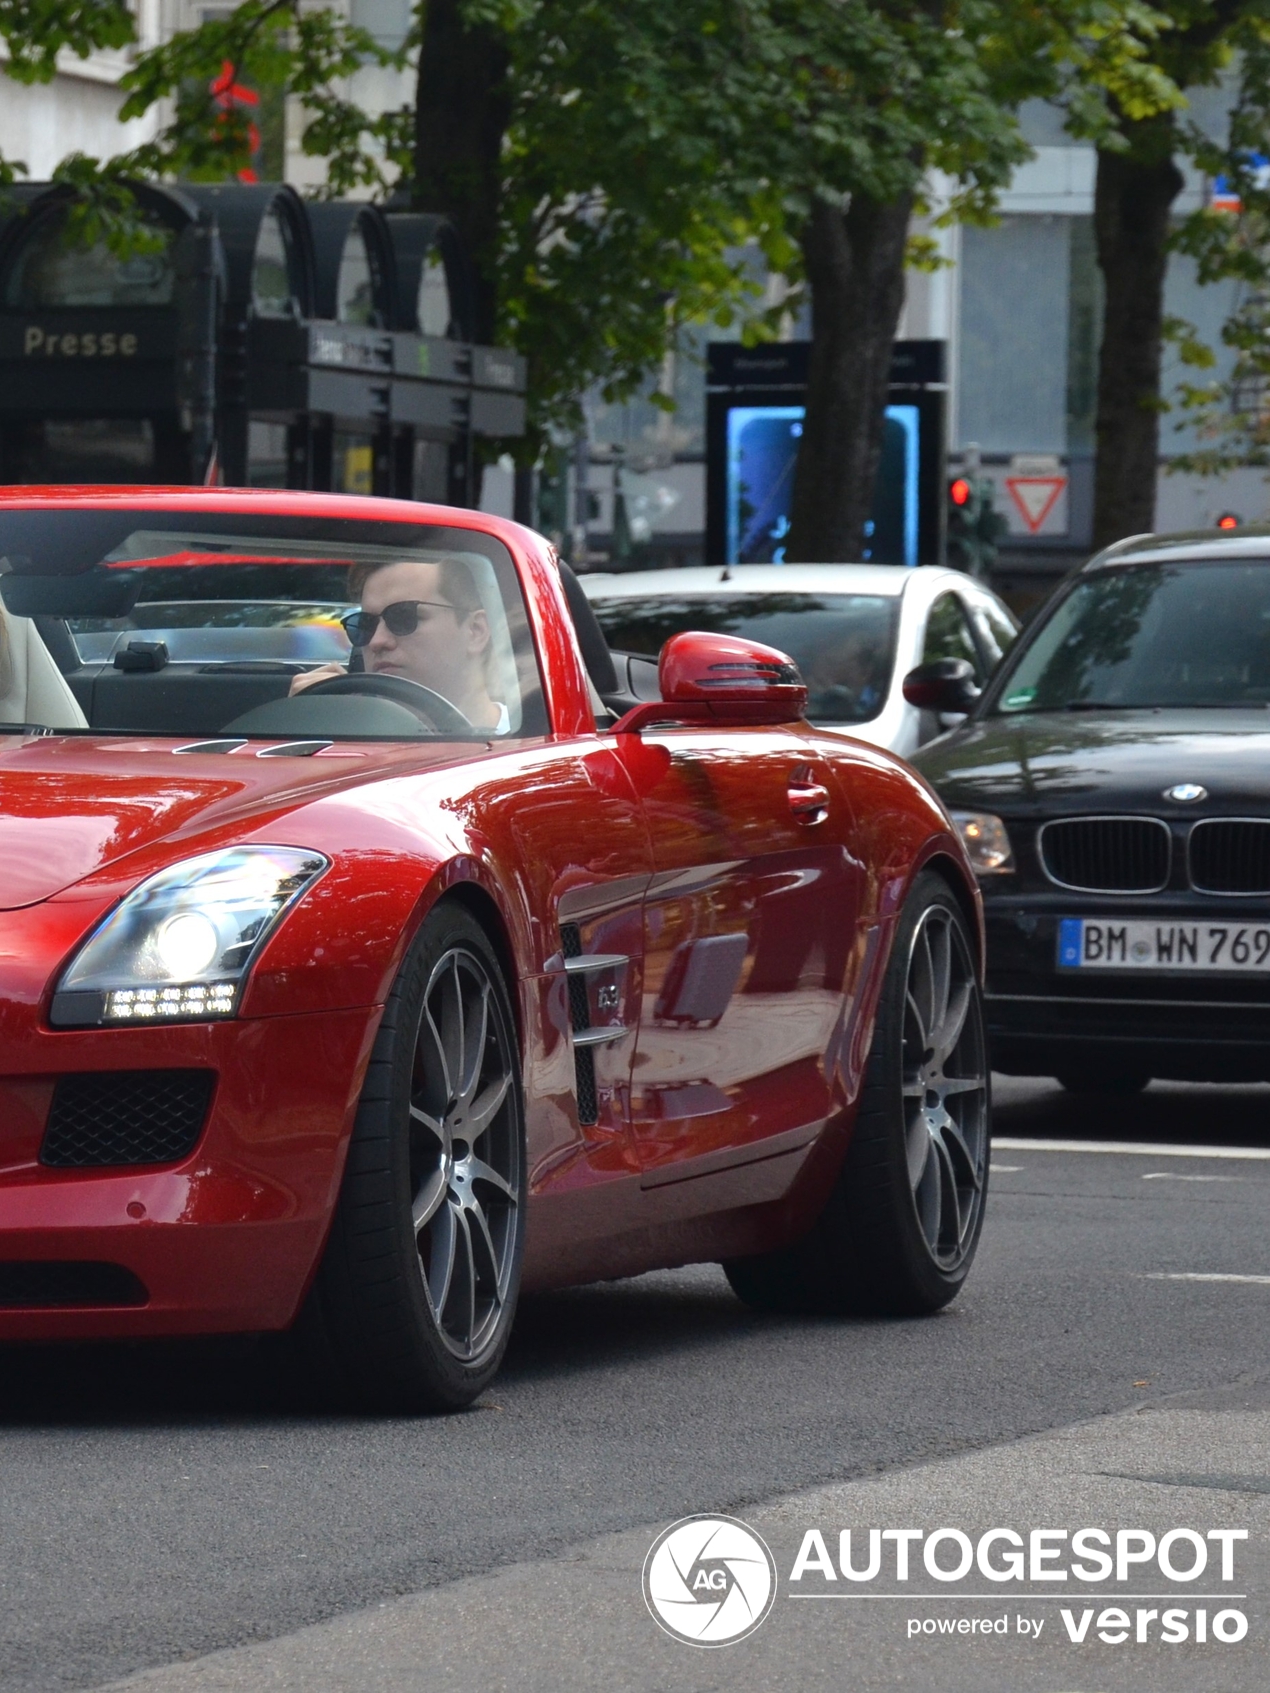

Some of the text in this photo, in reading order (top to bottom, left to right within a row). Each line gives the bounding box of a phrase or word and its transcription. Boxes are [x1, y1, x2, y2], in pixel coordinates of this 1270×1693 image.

[24, 325, 138, 355] Presse
[1085, 926, 1270, 965] BM WN 769
